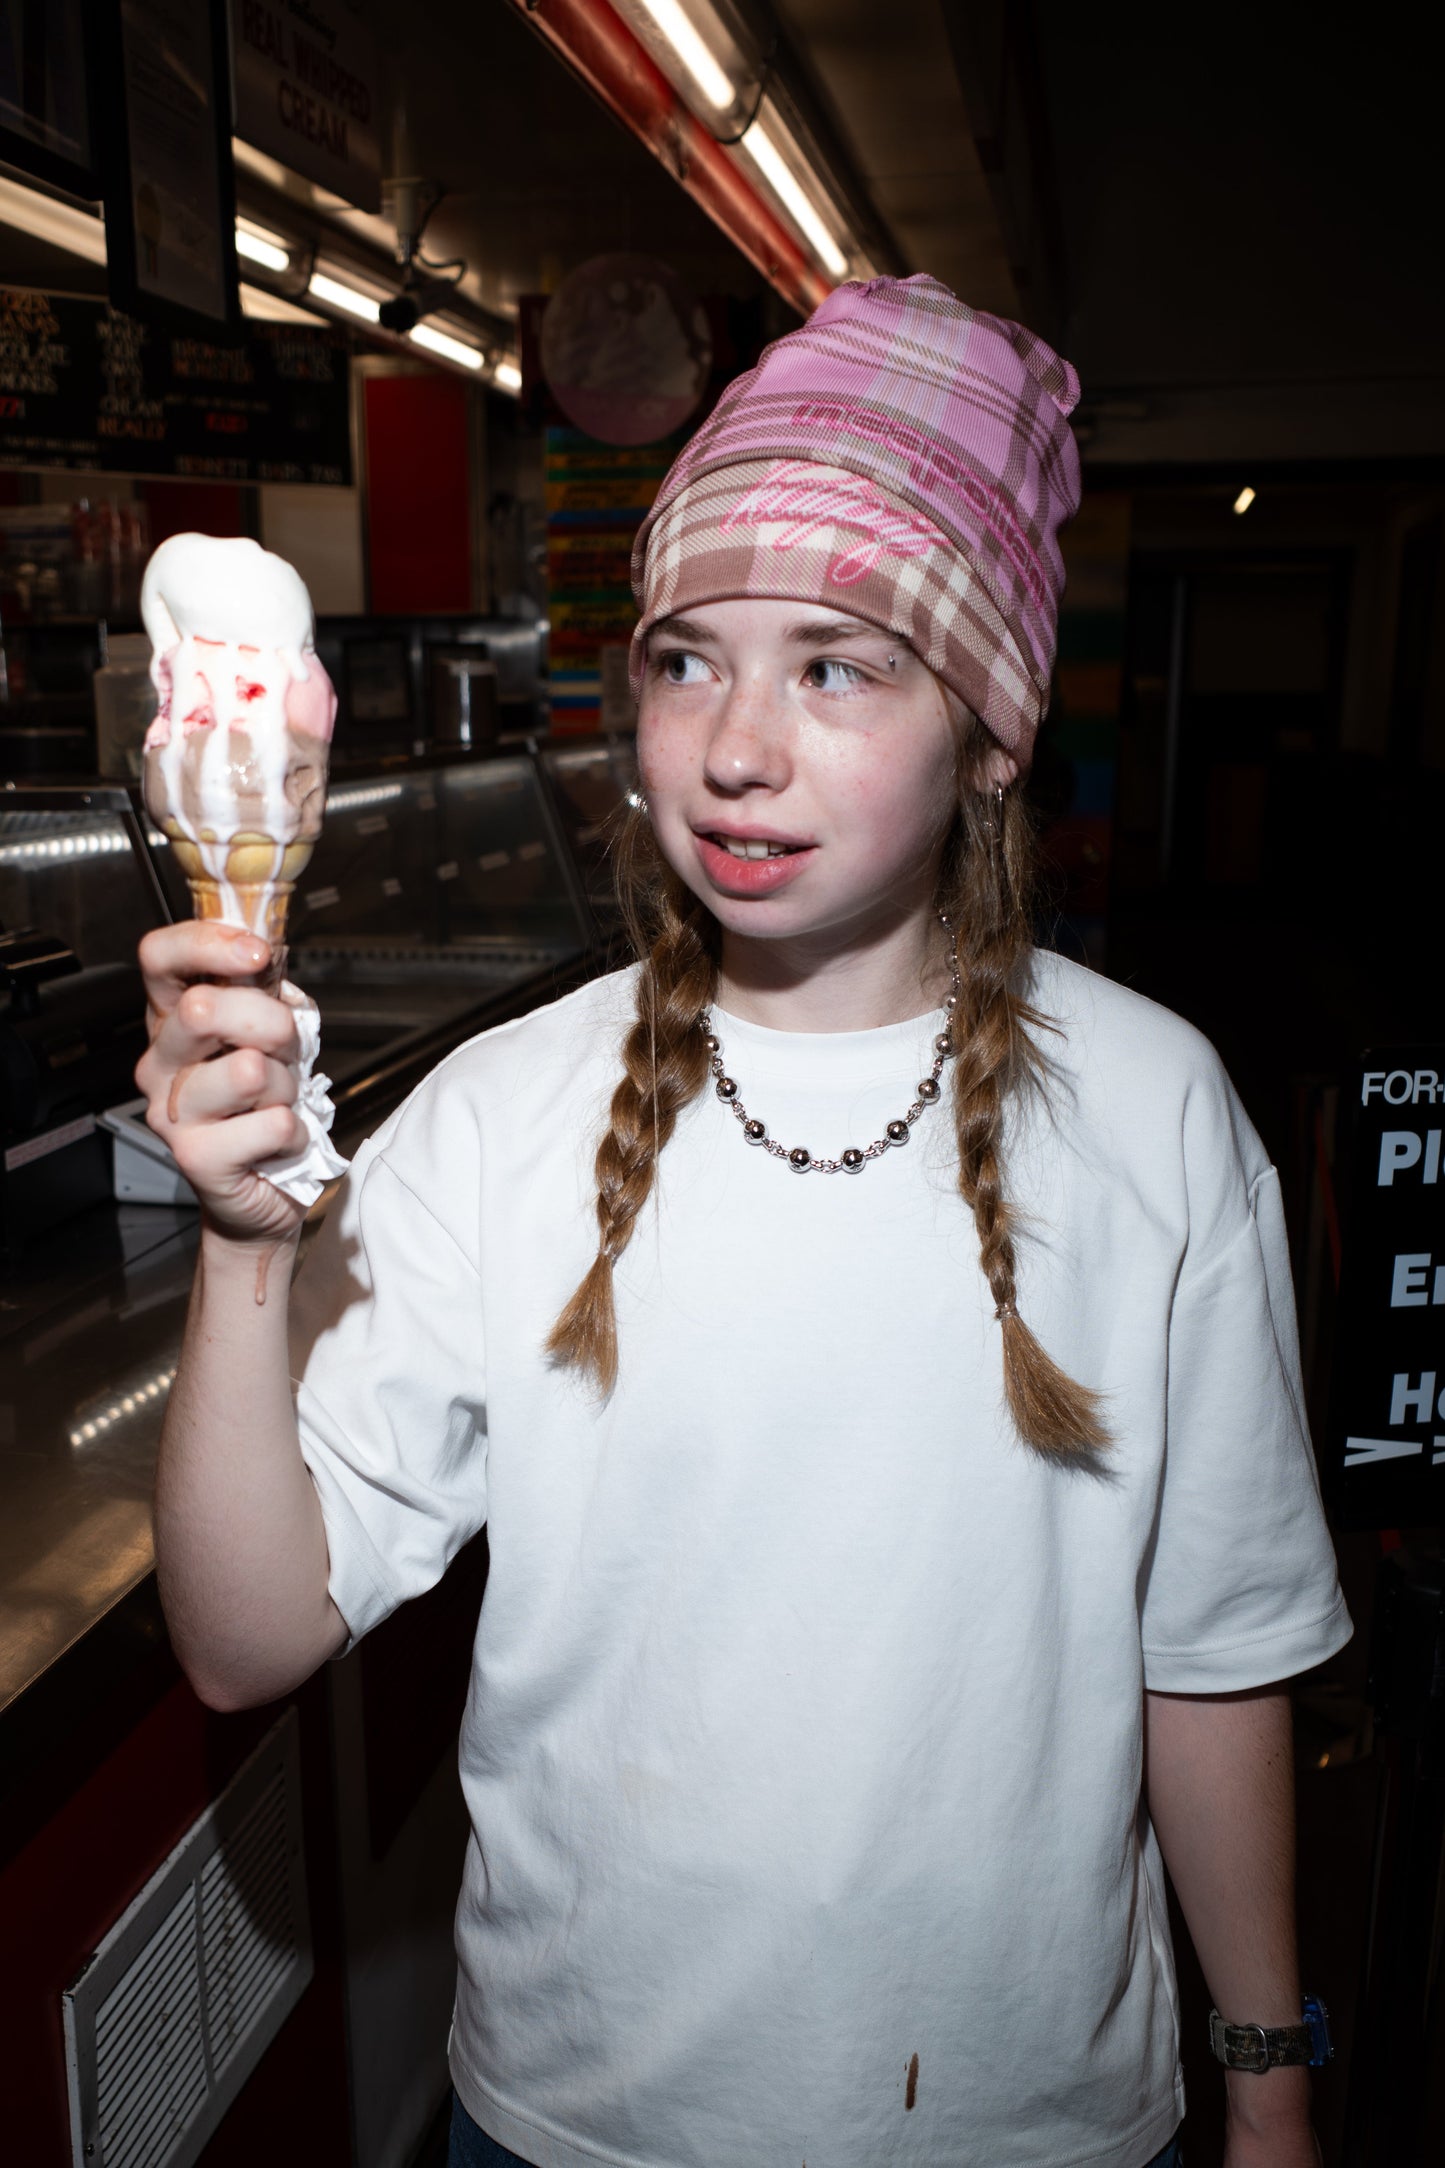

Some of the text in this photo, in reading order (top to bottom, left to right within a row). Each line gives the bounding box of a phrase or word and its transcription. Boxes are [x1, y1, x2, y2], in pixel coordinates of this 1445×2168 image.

[243, 0, 289, 70] REAL
[291, 30, 373, 124] WHIPPED
[278, 77, 350, 164] CREAM
[792, 401, 1047, 613] neapolitan
[1361, 1070, 1445, 1107] FOR-
[1377, 1128, 1445, 1187] Pl
[1388, 1370, 1445, 1426] H
